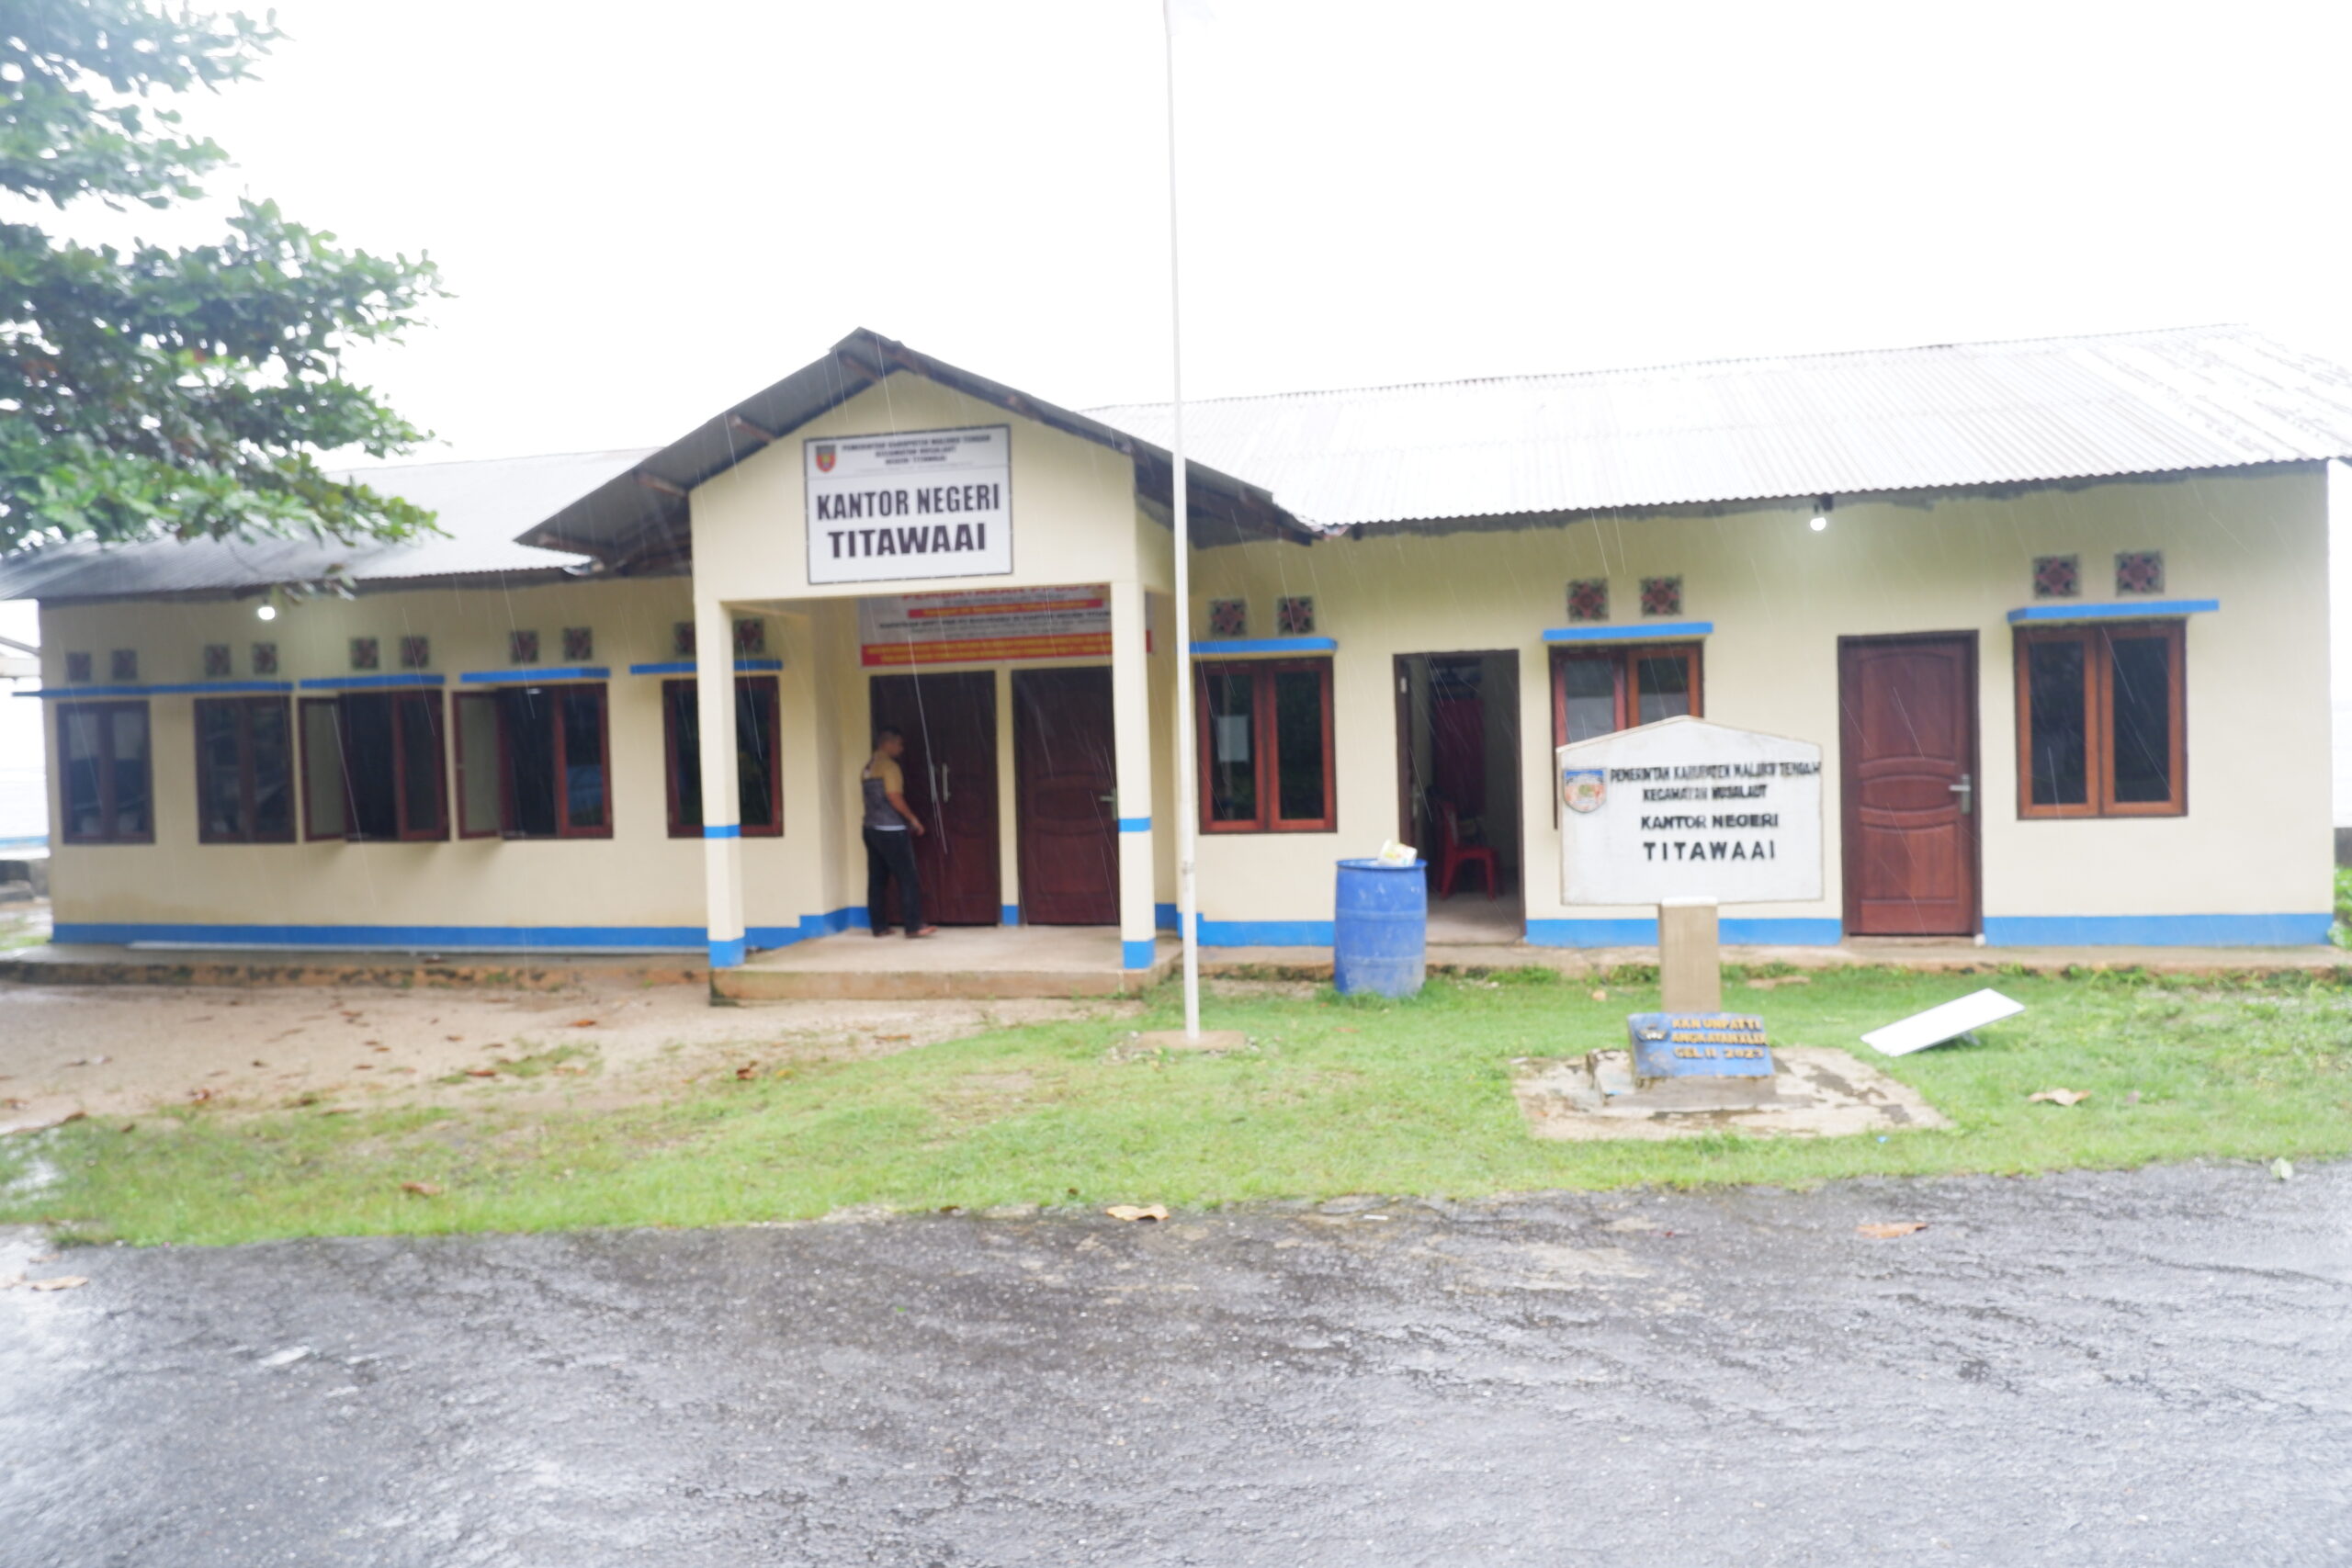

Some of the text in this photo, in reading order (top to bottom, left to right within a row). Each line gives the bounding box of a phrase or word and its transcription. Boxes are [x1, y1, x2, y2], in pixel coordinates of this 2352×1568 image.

[817, 483, 1000, 521] KANTOR NEGERI
[828, 523, 986, 558] TITAWAAI
[1610, 767, 1670, 783] PEMERINTAH
[1643, 786, 1707, 802] KECAMATAN
[1641, 813, 1779, 830] KANTOR NEGERI
[1643, 840, 1775, 862] TITAWAAI
